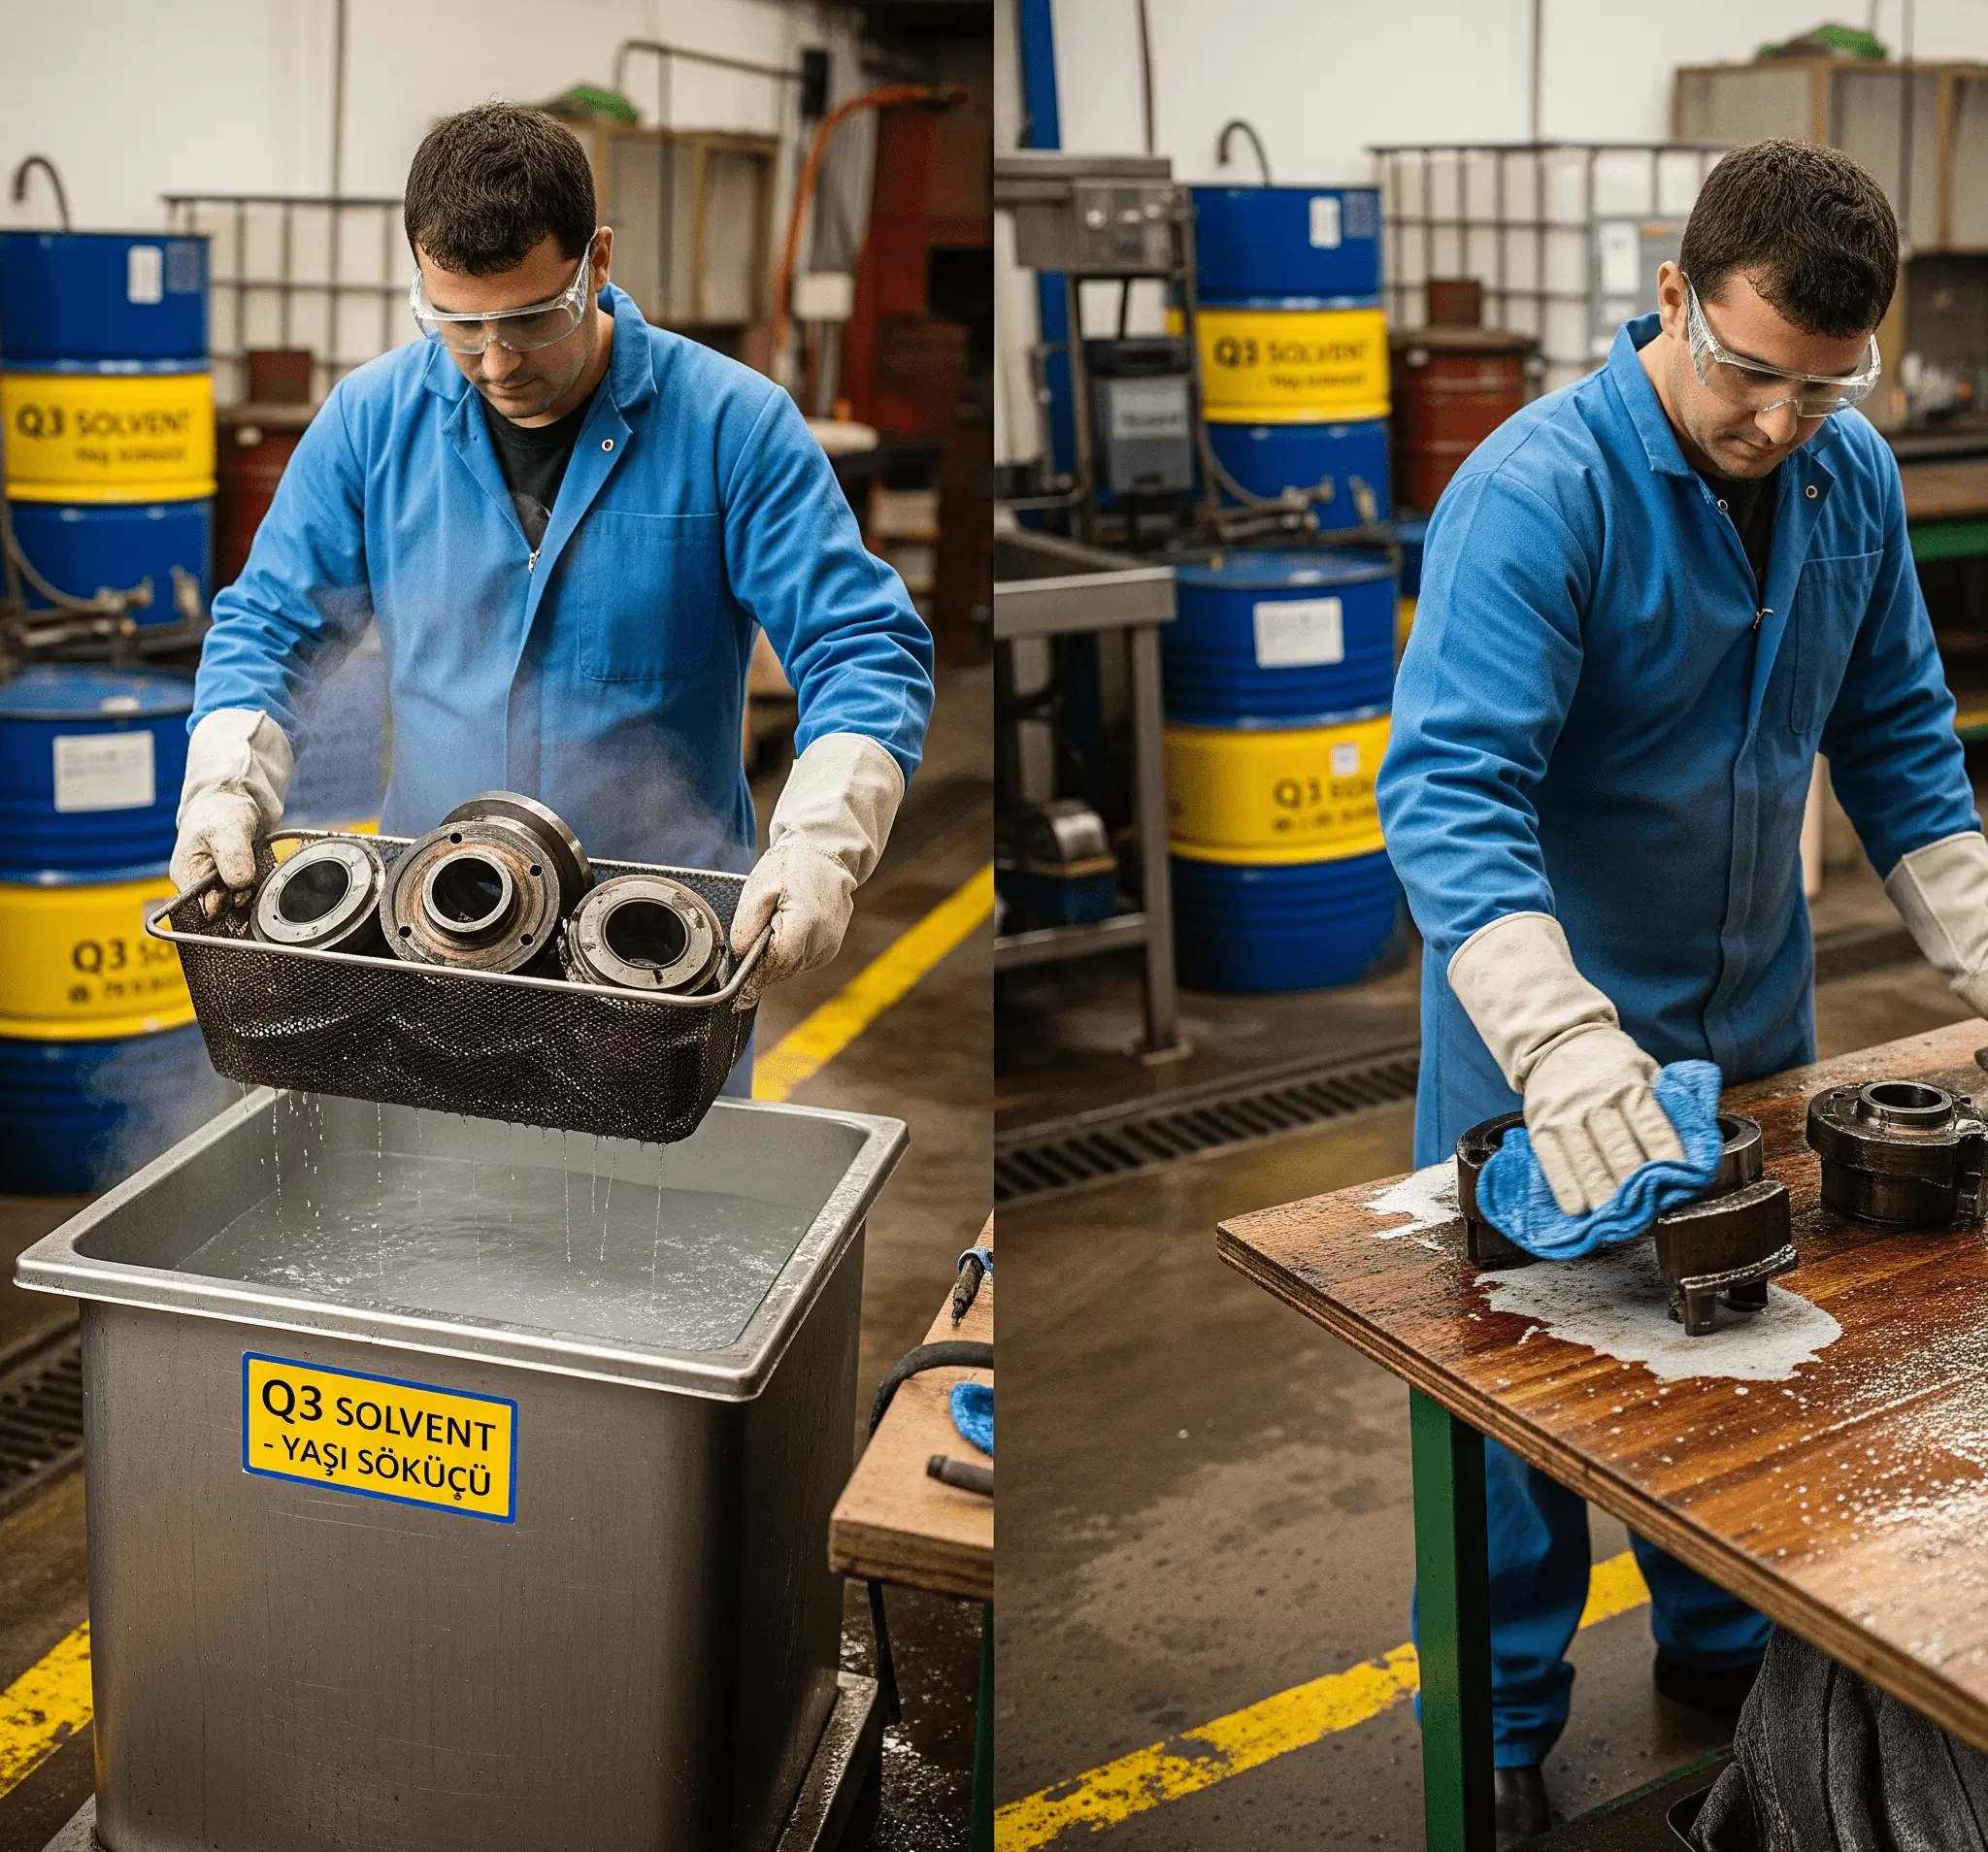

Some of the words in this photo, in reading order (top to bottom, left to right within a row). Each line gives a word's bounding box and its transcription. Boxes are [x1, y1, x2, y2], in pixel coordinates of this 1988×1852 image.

[1214, 336, 1258, 369] Q3
[16, 403, 65, 441] Q3
[74, 407, 191, 437] SOLVENT
[1273, 777, 1321, 810] Q3
[73, 938, 127, 976] Q3
[261, 1378, 323, 1424] Q3
[335, 1397, 496, 1451] SOLVENT
[282, 1434, 347, 1476] YAŞI
[357, 1446, 491, 1501] SÖKÜÇÜ
